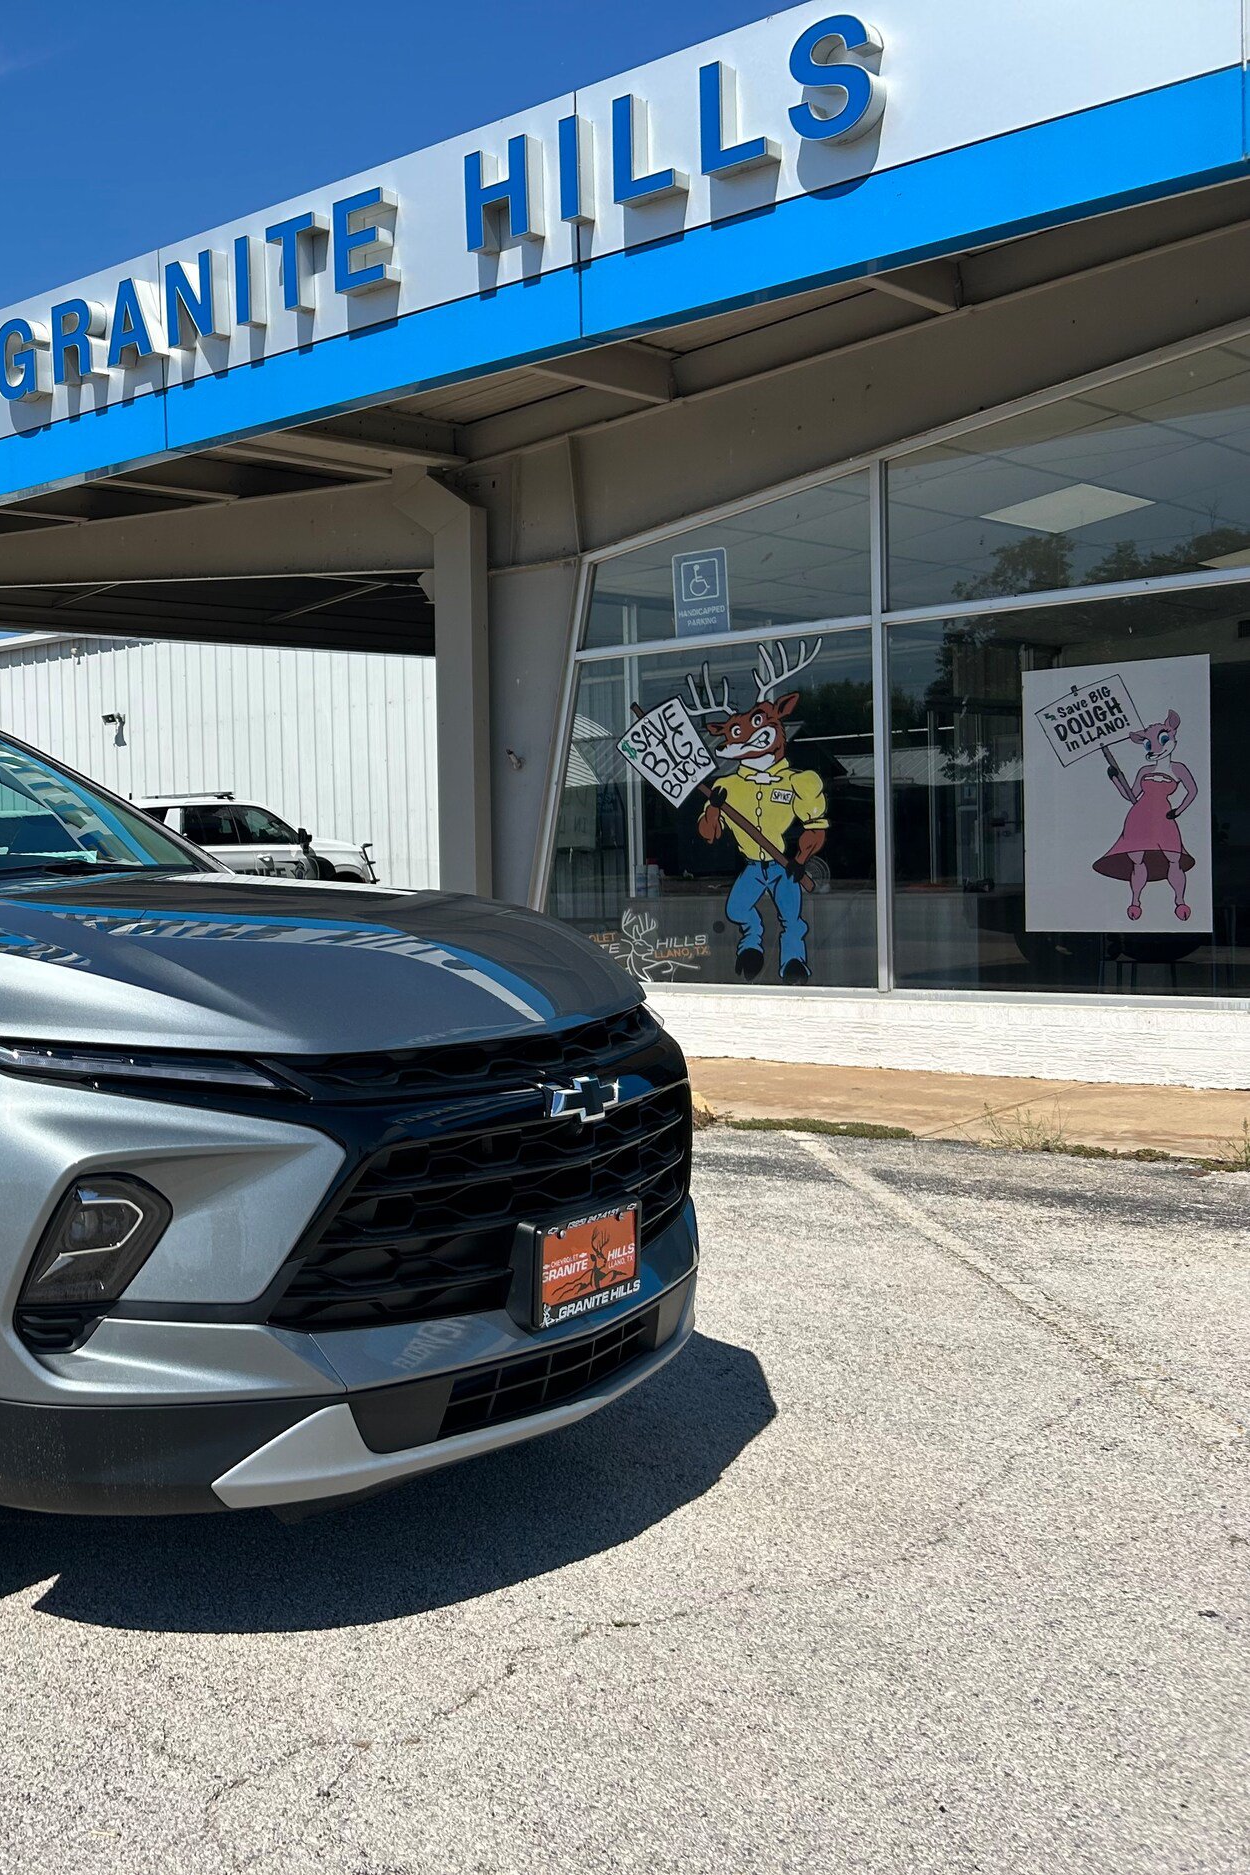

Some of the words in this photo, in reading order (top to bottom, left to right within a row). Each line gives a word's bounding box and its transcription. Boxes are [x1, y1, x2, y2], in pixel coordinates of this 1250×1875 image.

[463, 13, 883, 254] HILLS
[678, 605, 725, 618] HANDICAPPED
[687, 616, 717, 627] PARKING
[1053, 697, 1123, 742] DOUGH
[1057, 699, 1088, 718] Save
[1088, 686, 1111, 704] BIG
[631, 703, 685, 753] SAVE
[1065, 740, 1080, 752] in
[1079, 714, 1131, 746] LLANO!
[641, 730, 693, 778] BIG
[661, 747, 711, 799] BUCKS
[656, 934, 707, 950] HILLS
[696, 944, 710, 955] TX
[550, 1253, 579, 1268] CHEVROLET
[607, 1243, 635, 1262] HILLS
[558, 1290, 610, 1320] GRANITE
[610, 1279, 641, 1301] HILLS
